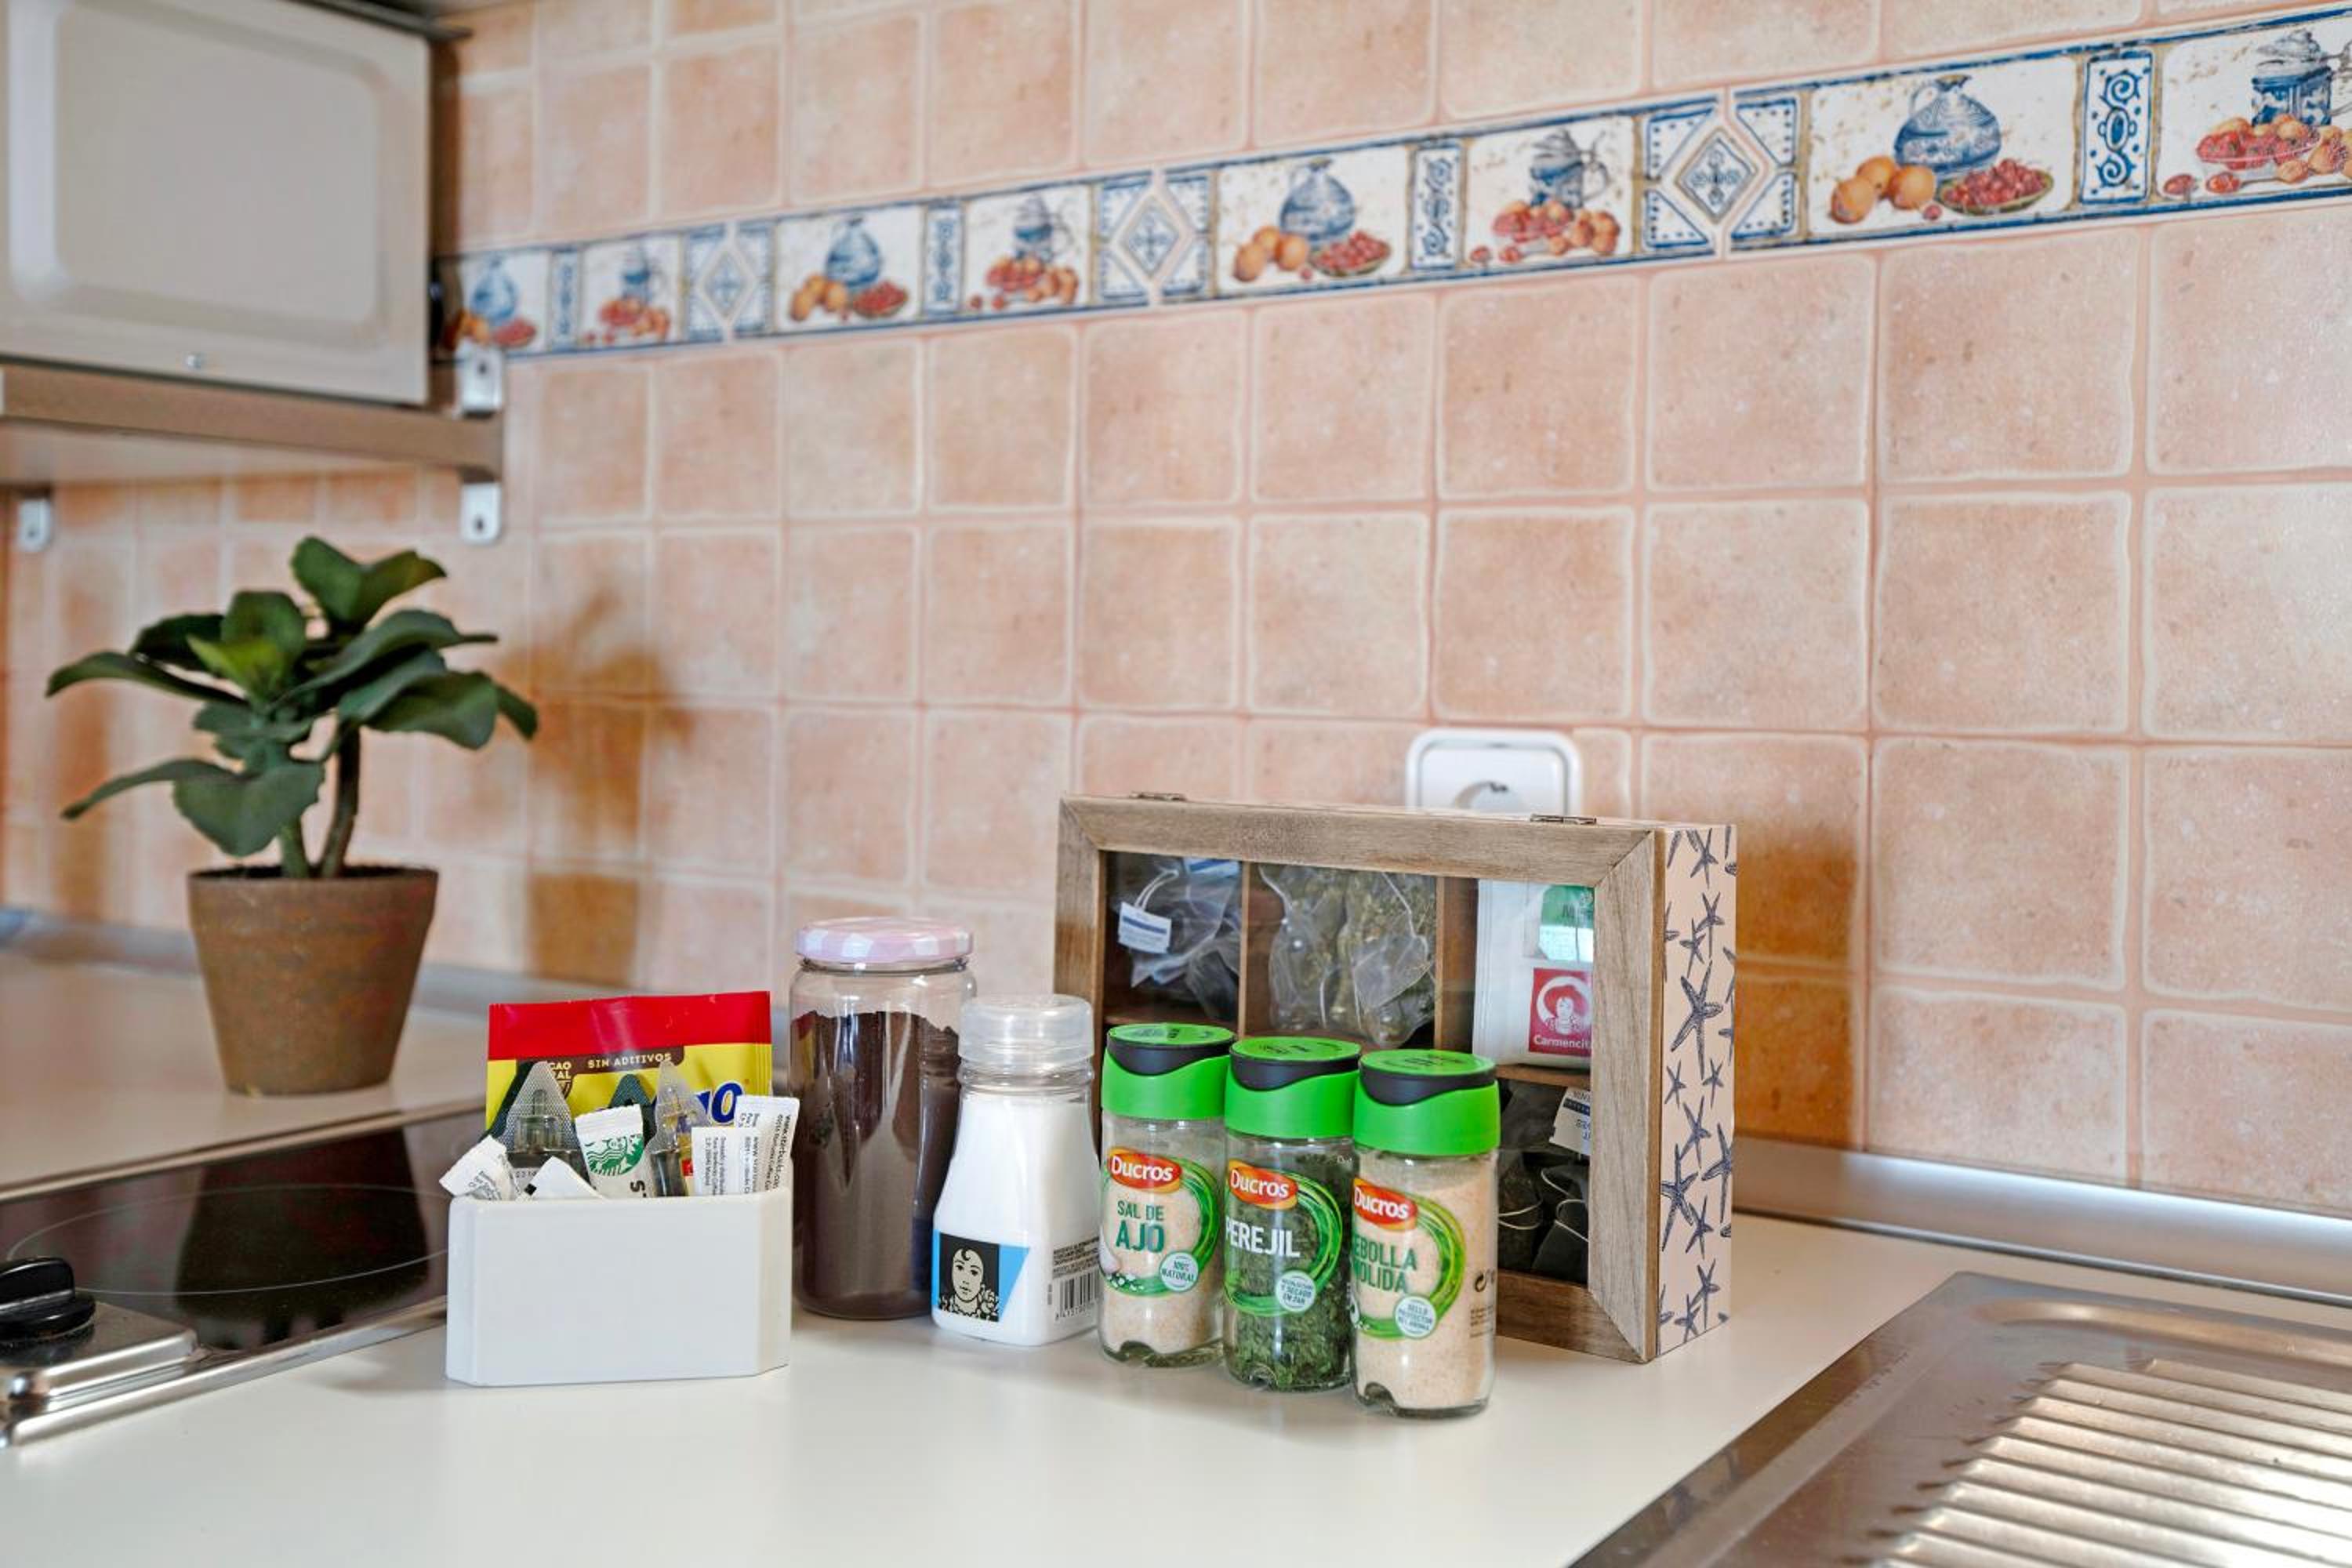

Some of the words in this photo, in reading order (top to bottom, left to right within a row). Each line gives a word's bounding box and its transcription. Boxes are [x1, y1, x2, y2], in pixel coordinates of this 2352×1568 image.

[588, 1059, 609, 1069] SIN
[614, 1052, 672, 1067] ADITIVOS
[1111, 1155, 1174, 1181] Ducros
[1230, 1169, 1290, 1199] Ducros
[1117, 1200, 1141, 1220] SAL
[1145, 1204, 1164, 1221] DE
[1354, 1186, 1410, 1220] Ducros
[1116, 1219, 1165, 1254] AJO
